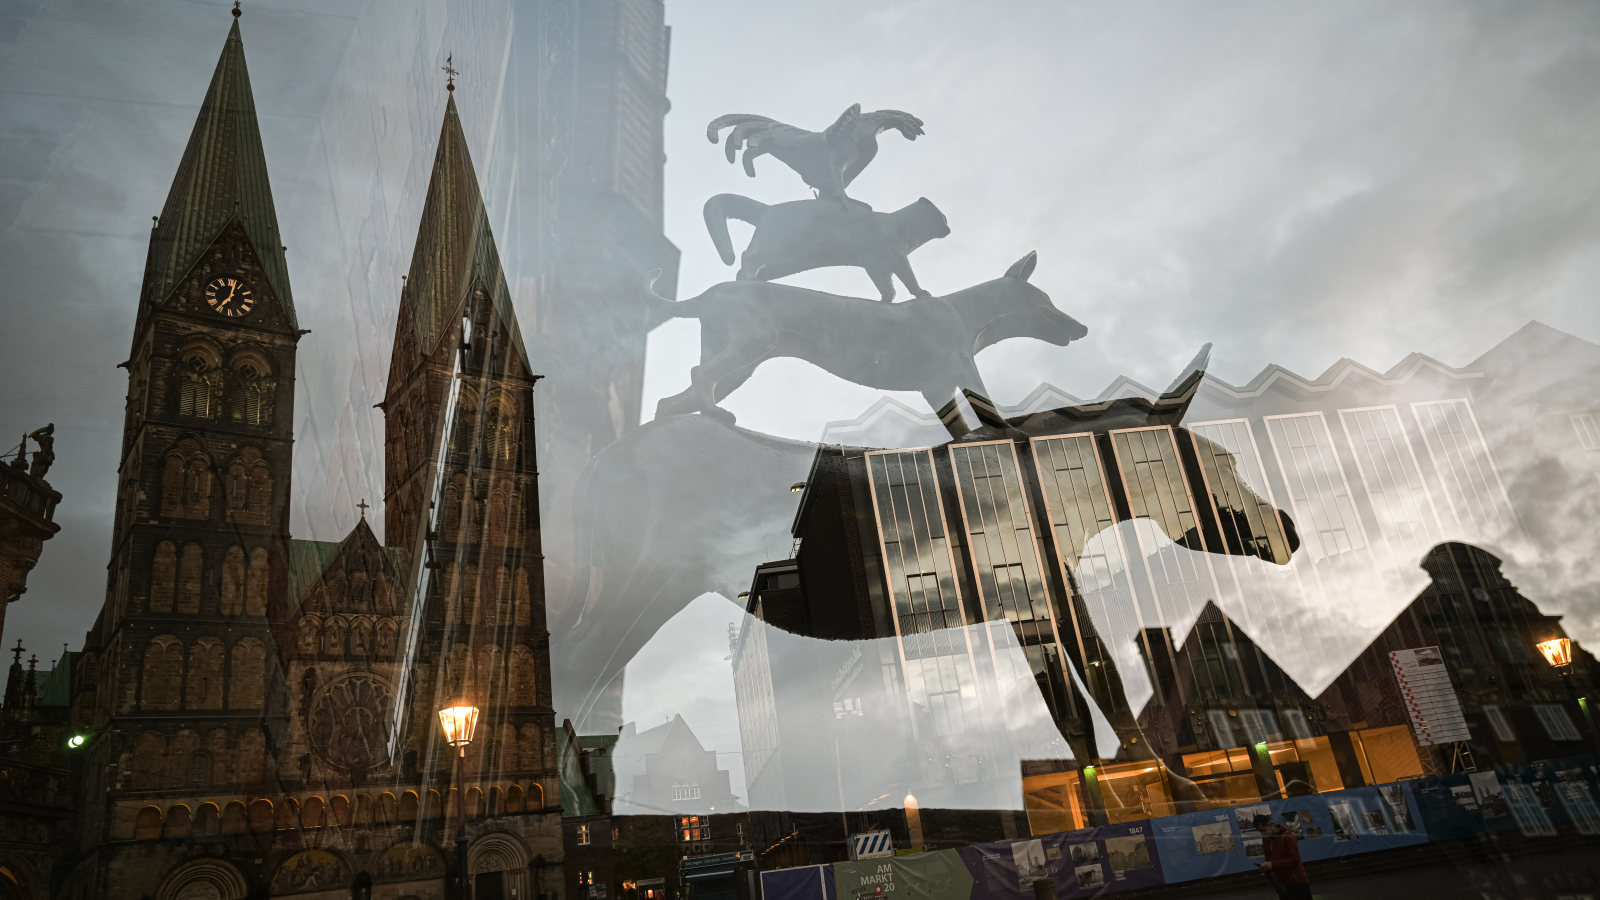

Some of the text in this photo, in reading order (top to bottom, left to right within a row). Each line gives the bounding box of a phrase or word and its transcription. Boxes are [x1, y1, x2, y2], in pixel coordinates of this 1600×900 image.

[1128, 826, 1143, 835] 1847
[877, 863, 892, 874] AM
[860, 873, 893, 886] MARKT
[883, 883, 895, 892] 20
